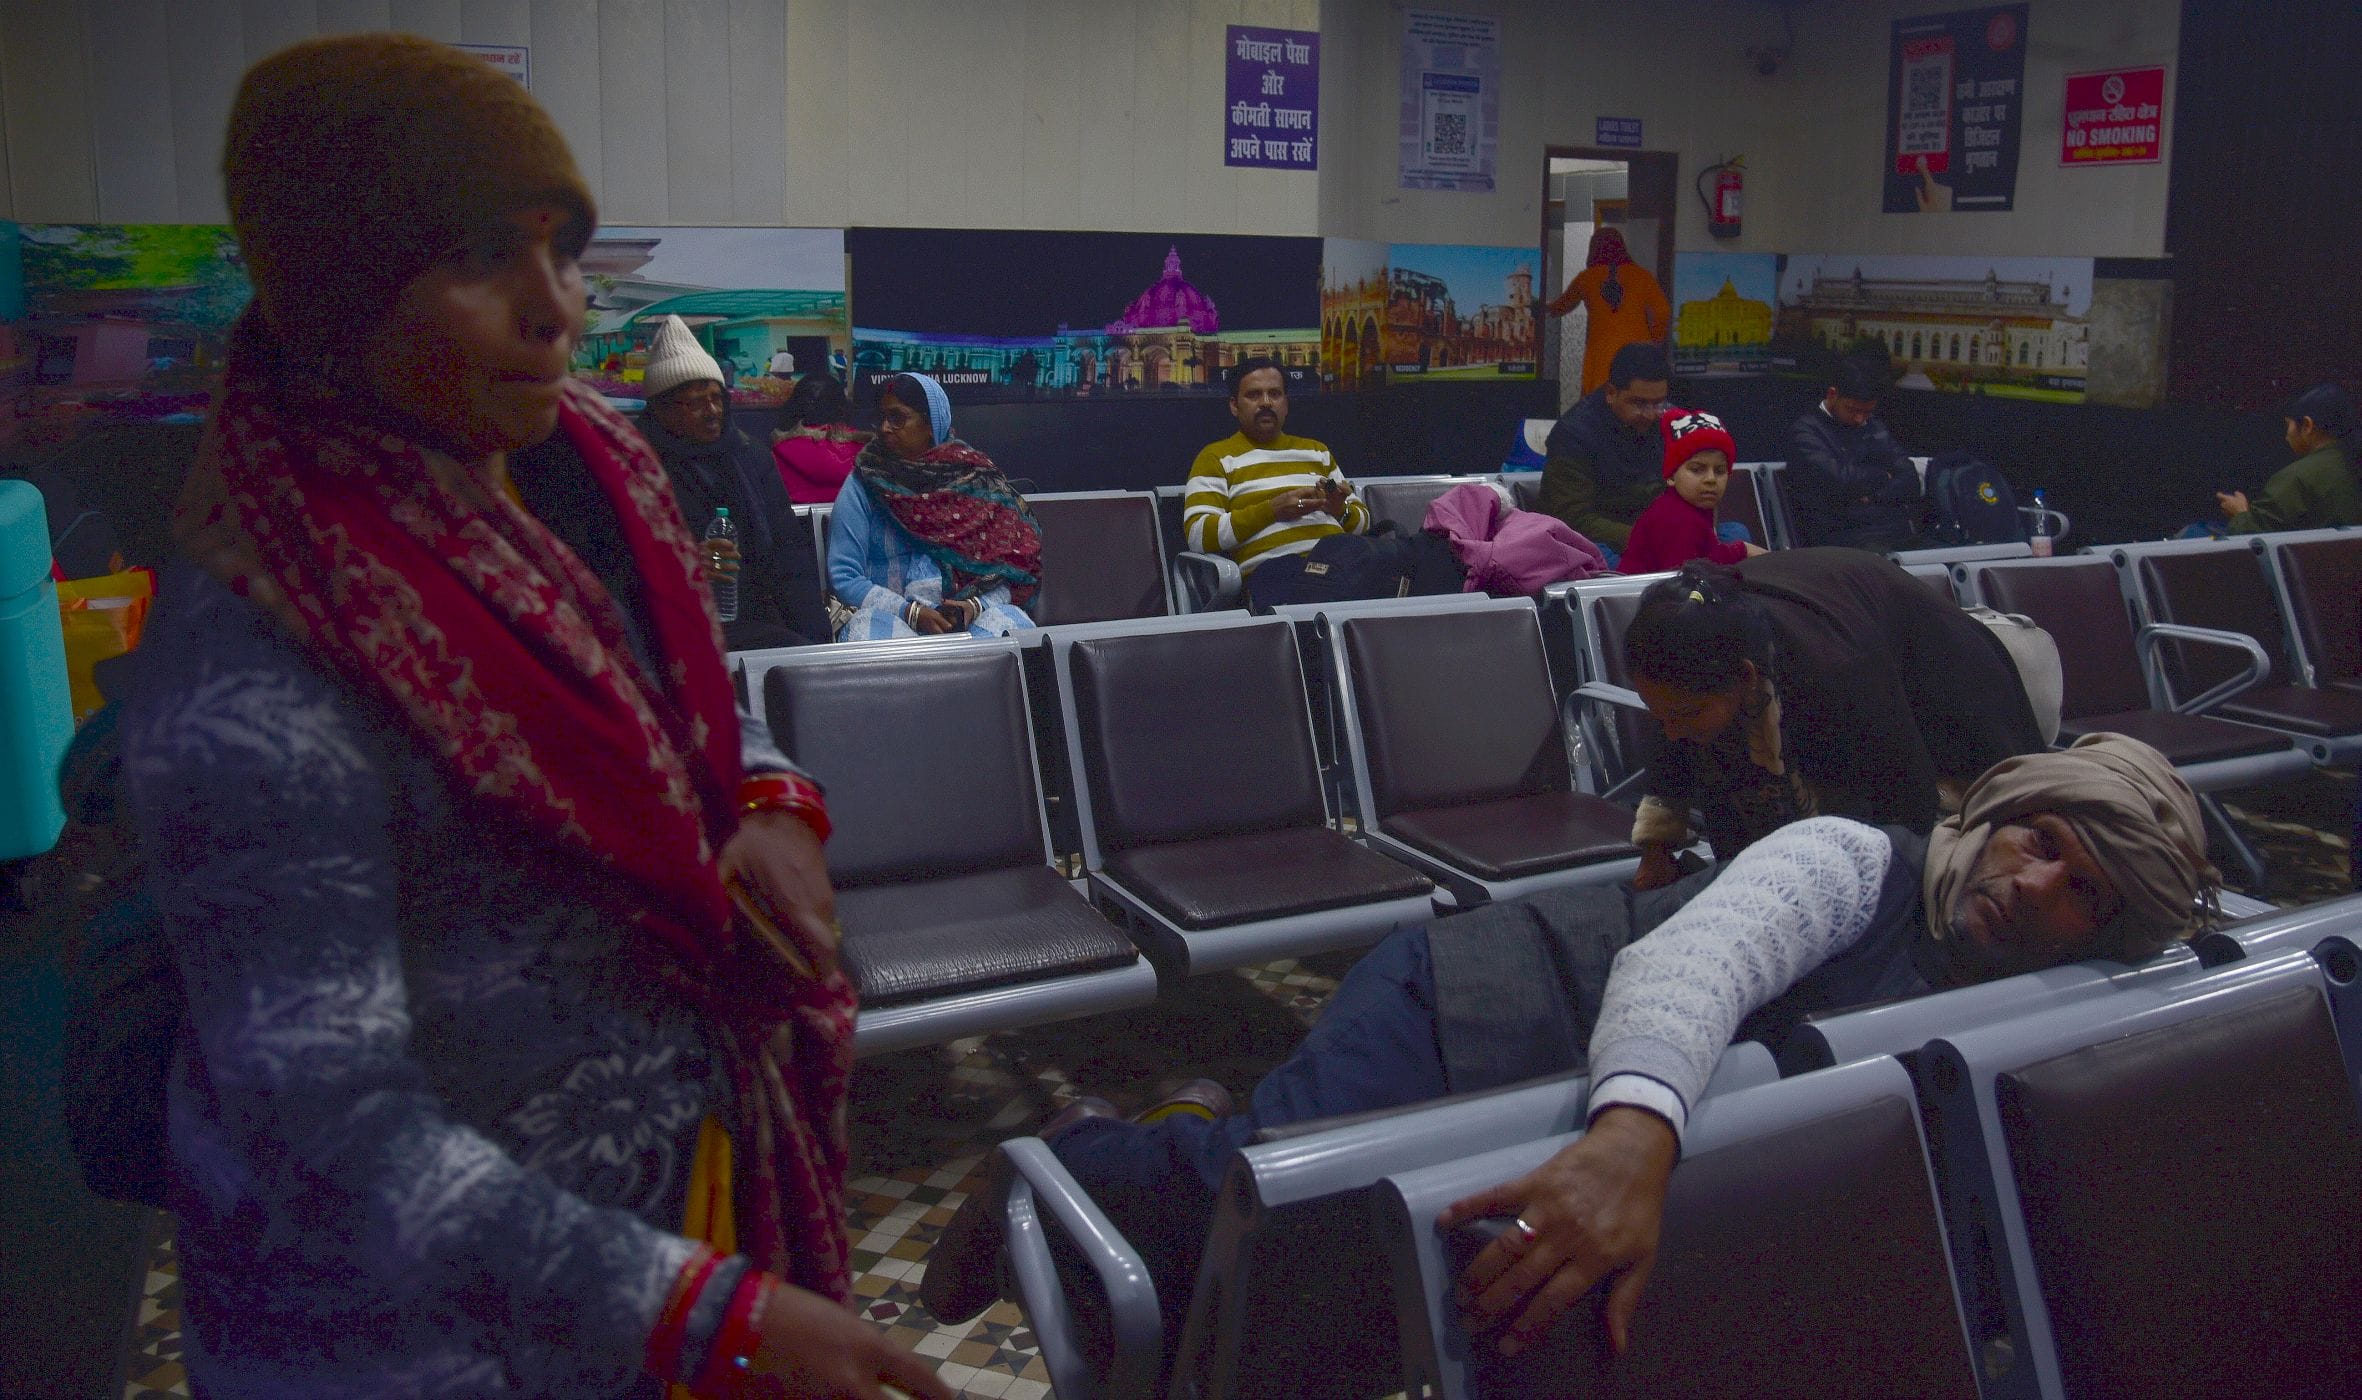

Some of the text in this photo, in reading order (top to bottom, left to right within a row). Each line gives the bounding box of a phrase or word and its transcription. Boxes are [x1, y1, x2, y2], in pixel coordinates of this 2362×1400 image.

[1236, 35, 1309, 64] मोबाइल पैसा
[1262, 70, 1284, 95] और
[1231, 101, 1312, 129] कीमती सामान
[1231, 134, 1313, 162] अपने पास रखें
[2066, 124, 2156, 147] NO SMOKING
[943, 373, 988, 384] LUCKNOW
